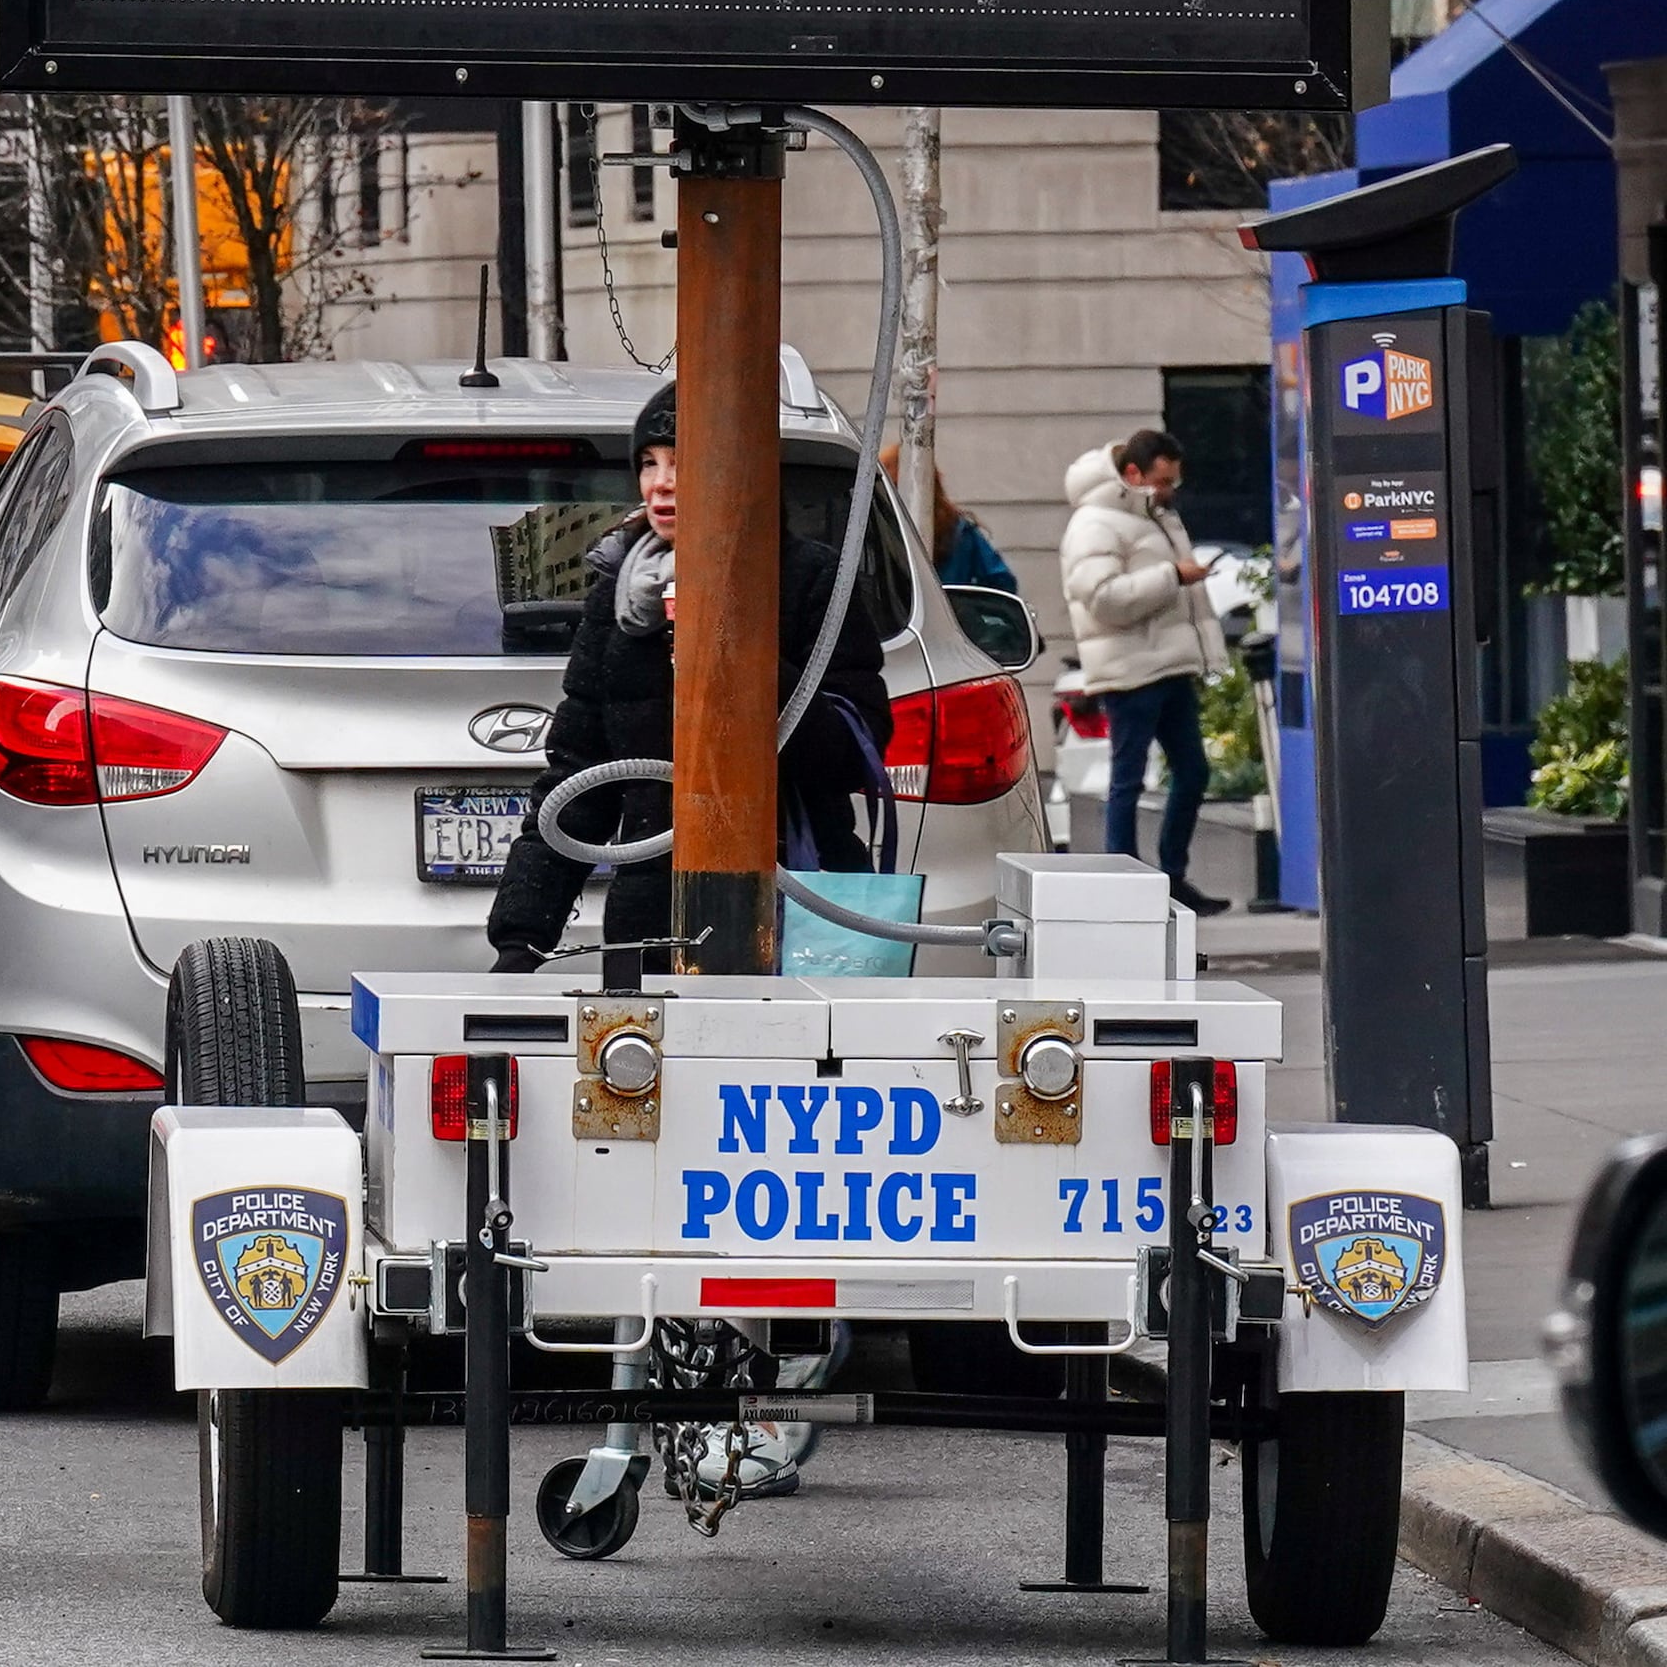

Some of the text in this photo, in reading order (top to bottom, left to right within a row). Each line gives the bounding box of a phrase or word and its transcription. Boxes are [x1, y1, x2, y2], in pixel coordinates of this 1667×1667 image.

[1388, 354, 1426, 381] PARK
[1345, 360, 1382, 409] P
[1390, 382, 1429, 414] NYC
[1364, 490, 1435, 507] ParkNYC
[1350, 582, 1439, 609] 104708
[467, 797, 510, 815] NEW
[143, 845, 250, 864] HYUNDAI
[718, 1084, 942, 1155] NYPD
[232, 1193, 305, 1212] POLICE
[681, 1169, 977, 1242] POLICE
[1058, 1177, 1165, 1232] 715
[1329, 1197, 1402, 1215] POLICE
[203, 1210, 337, 1242] DEPARTMENT
[1300, 1214, 1435, 1245] DEPARTMENT
[1420, 1253, 1439, 1288] ORK
[203, 1251, 339, 1334] CITY OF NEW YORK
